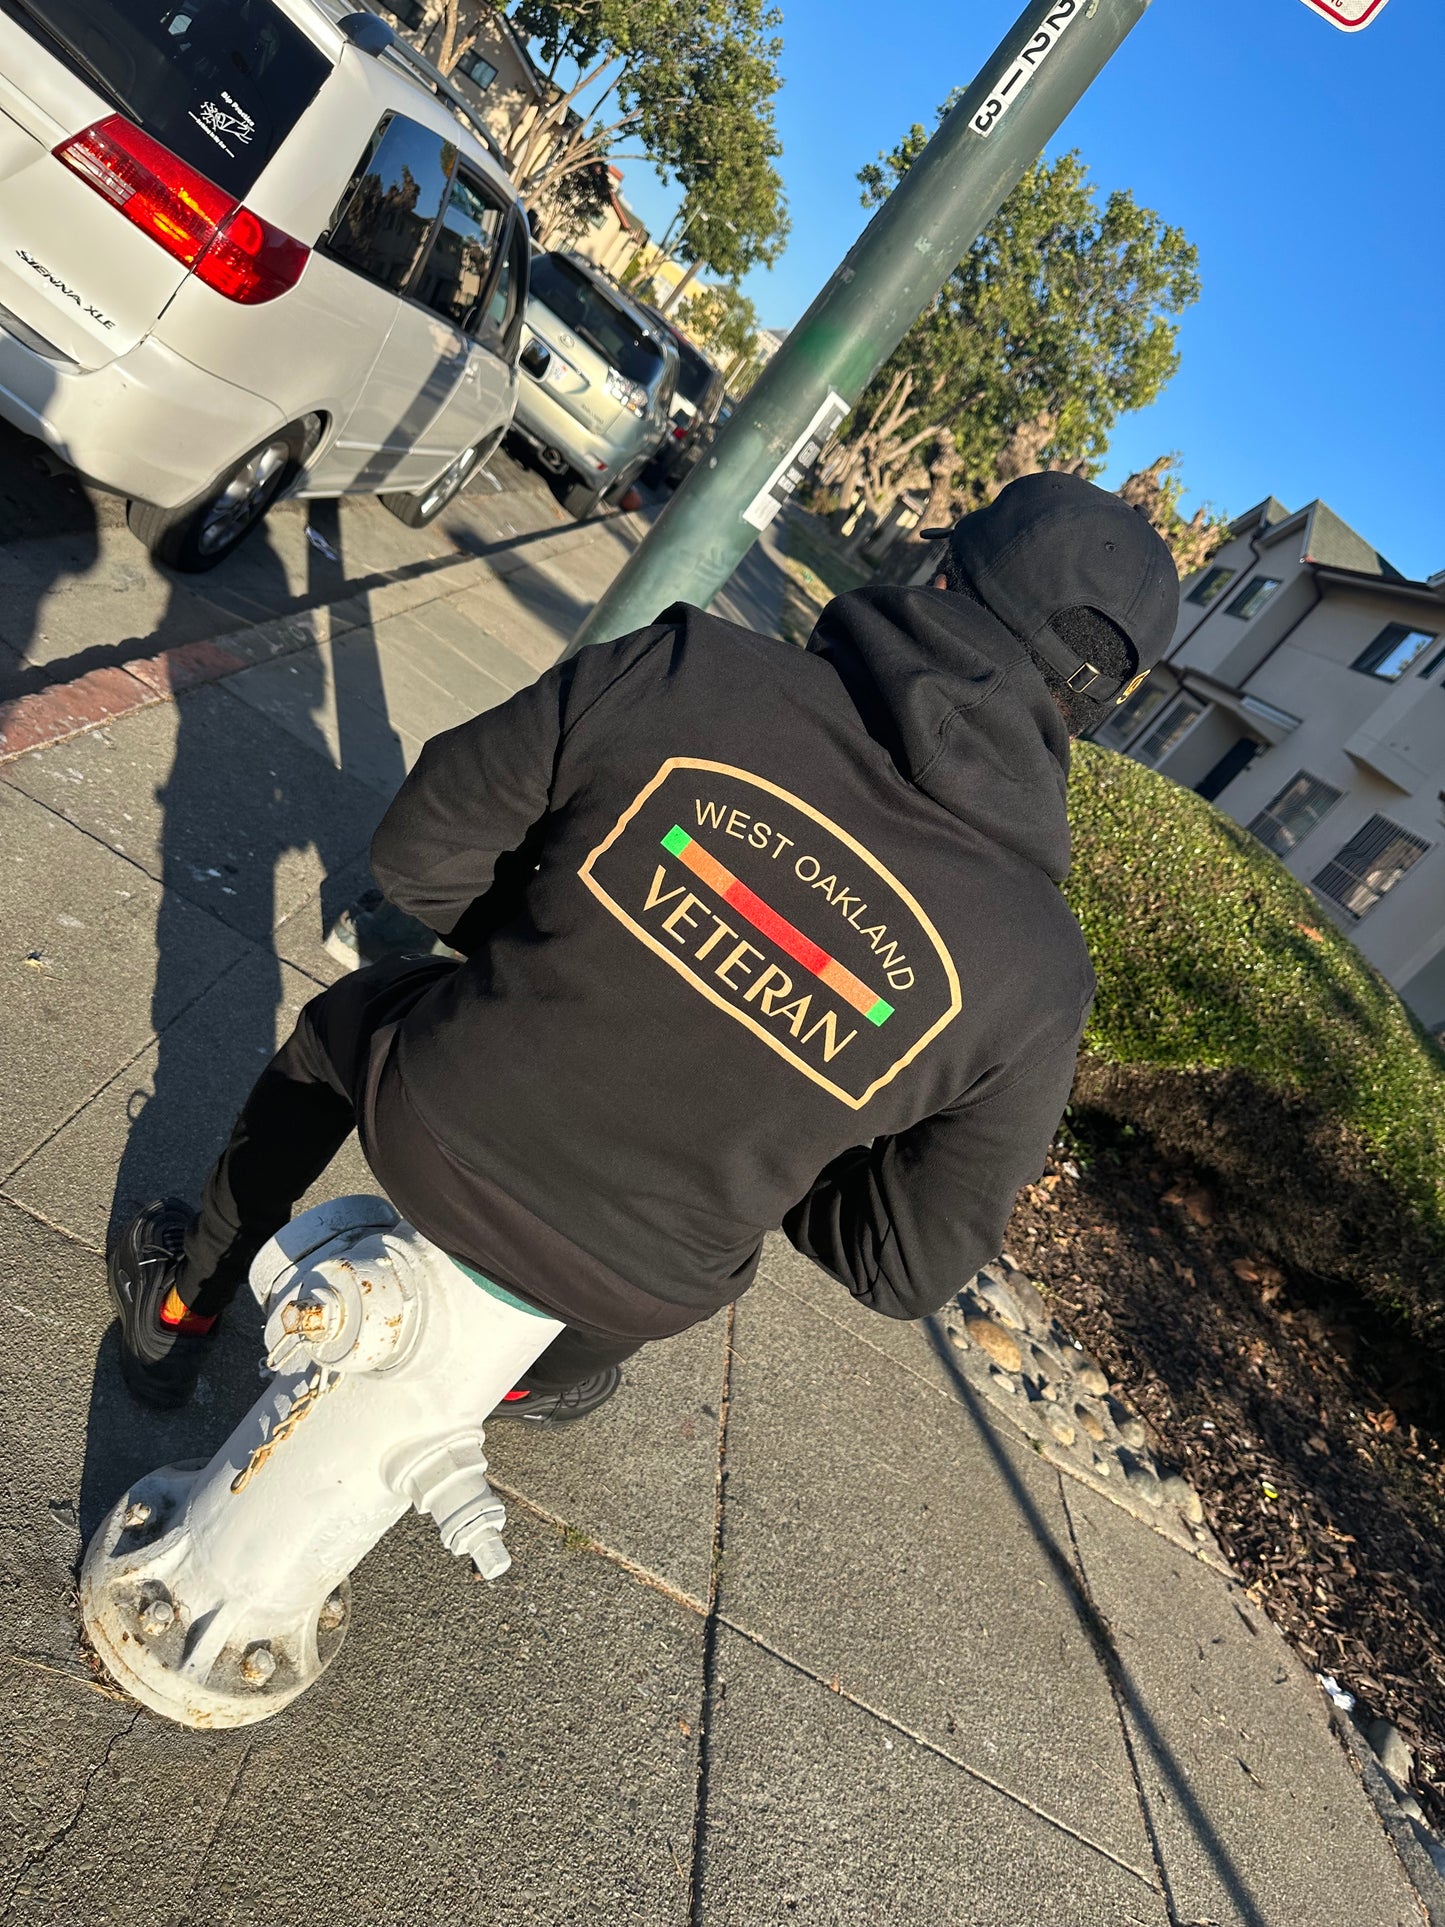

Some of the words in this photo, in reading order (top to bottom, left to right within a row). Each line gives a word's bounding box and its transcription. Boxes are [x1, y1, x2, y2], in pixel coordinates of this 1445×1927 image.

[231, 102, 255, 127] Practice
[16, 250, 81, 306] SIENNA
[83, 305, 116, 330] XLE
[695, 799, 794, 859] WEST
[794, 855, 915, 990] OAKLAND
[643, 864, 857, 1063] VETERAN
